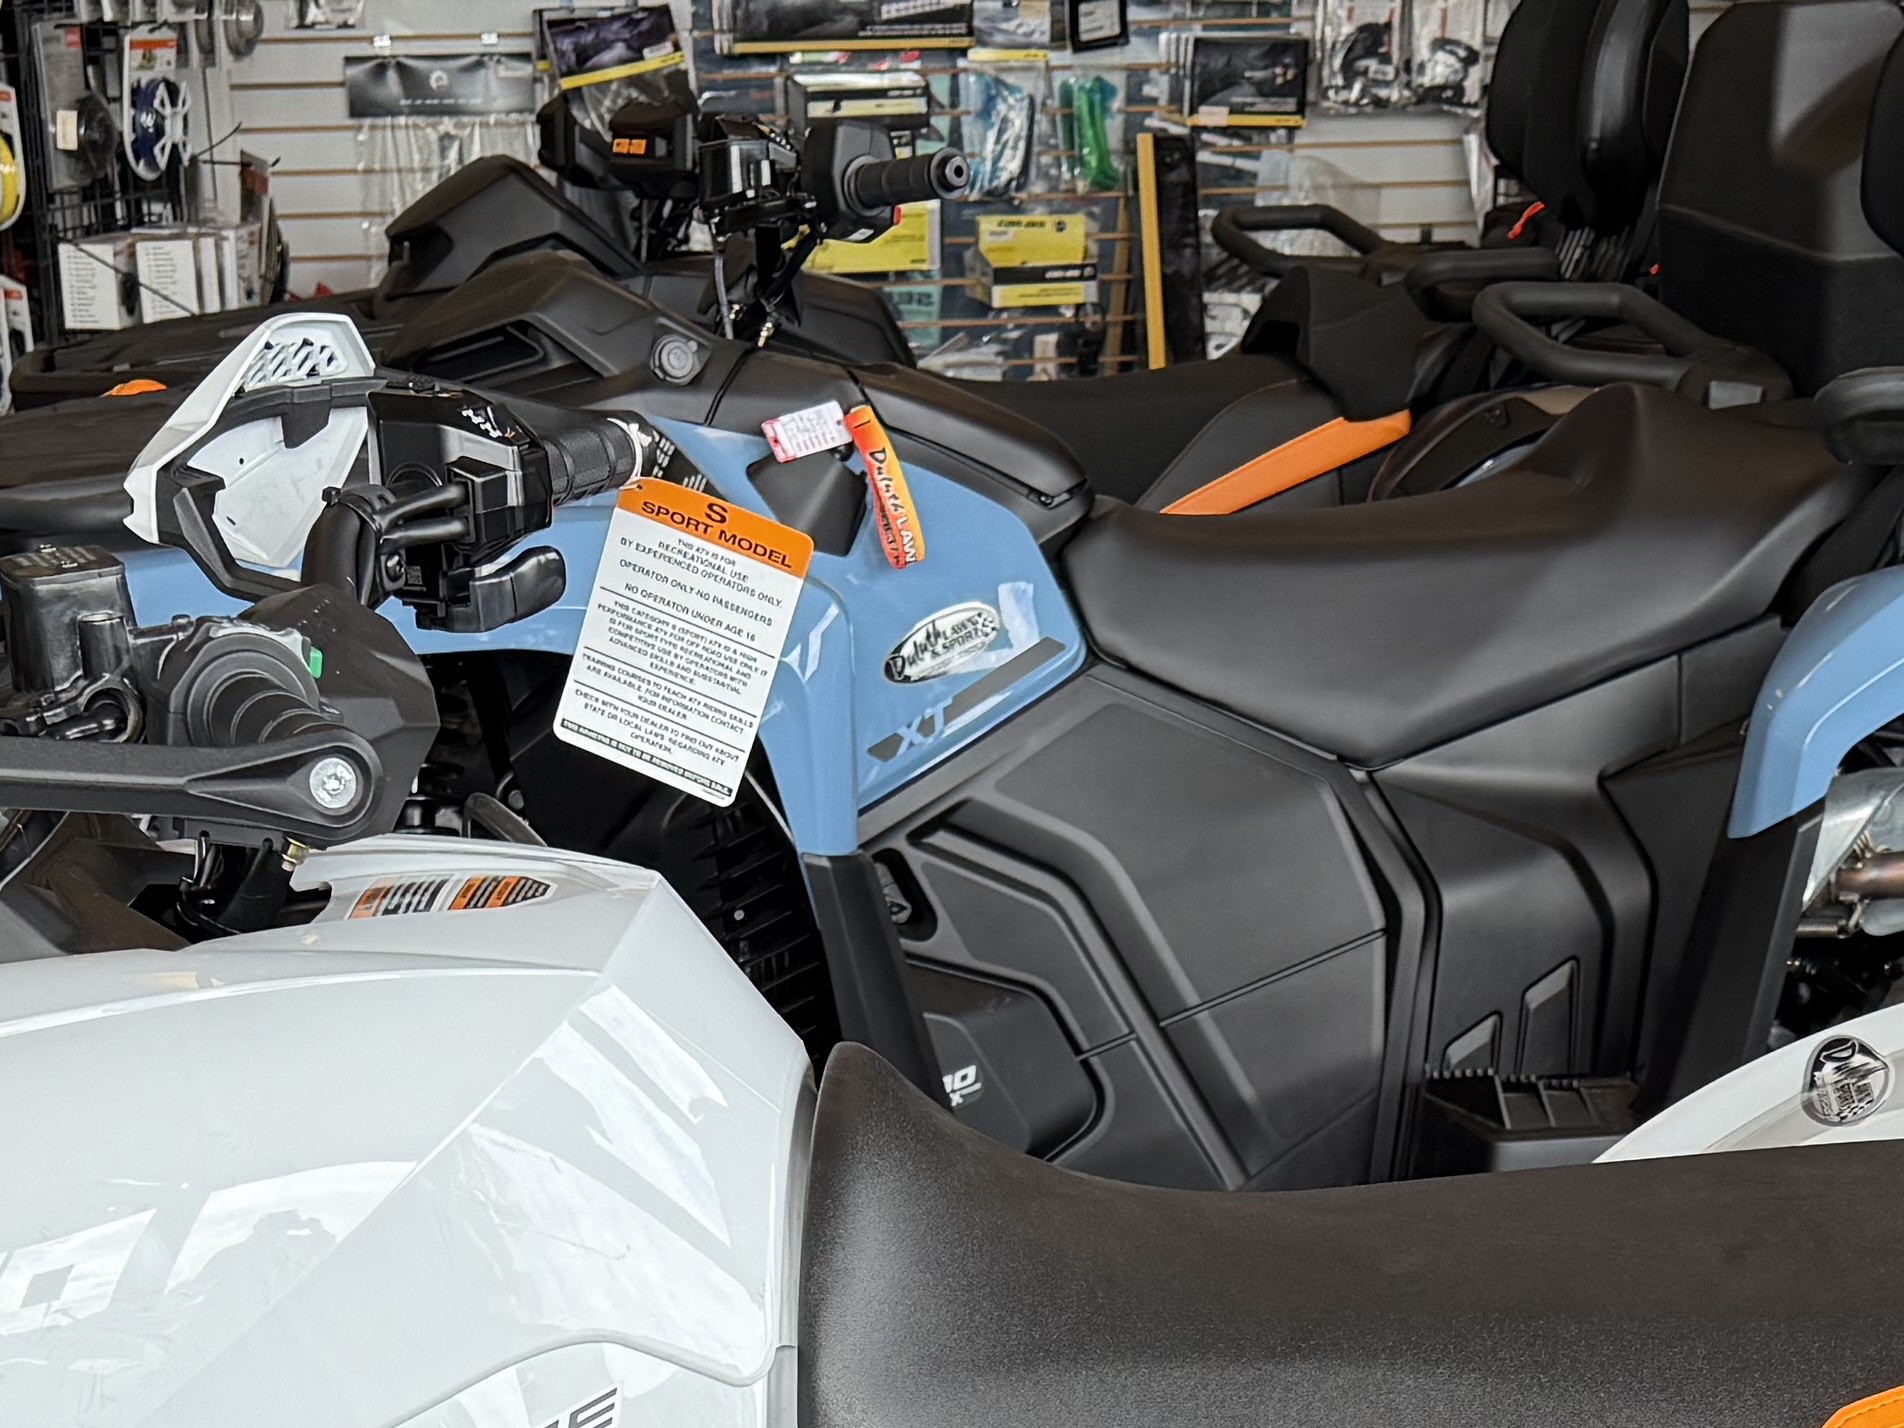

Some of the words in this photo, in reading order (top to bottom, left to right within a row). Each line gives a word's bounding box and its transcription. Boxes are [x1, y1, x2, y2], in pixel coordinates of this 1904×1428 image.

[639, 499, 714, 537] SPORT
[716, 529, 795, 569] MODEL
[704, 502, 728, 524] S
[617, 558, 669, 585] OPERATOR
[710, 595, 774, 627] PASSENGERS
[619, 536, 633, 548] BY
[633, 542, 700, 576] EXPERIENCED
[699, 568, 757, 598] OPERATORS
[755, 591, 784, 609] ONLY.
[656, 540, 729, 576] RECREATIONAL
[729, 569, 749, 584] USE
[623, 582, 639, 595] NO
[638, 588, 690, 616] OPERATOR
[689, 609, 724, 629] UNDER
[723, 622, 744, 638] AGE
[889, 615, 943, 679] Duluth
[897, 697, 953, 755] XT
